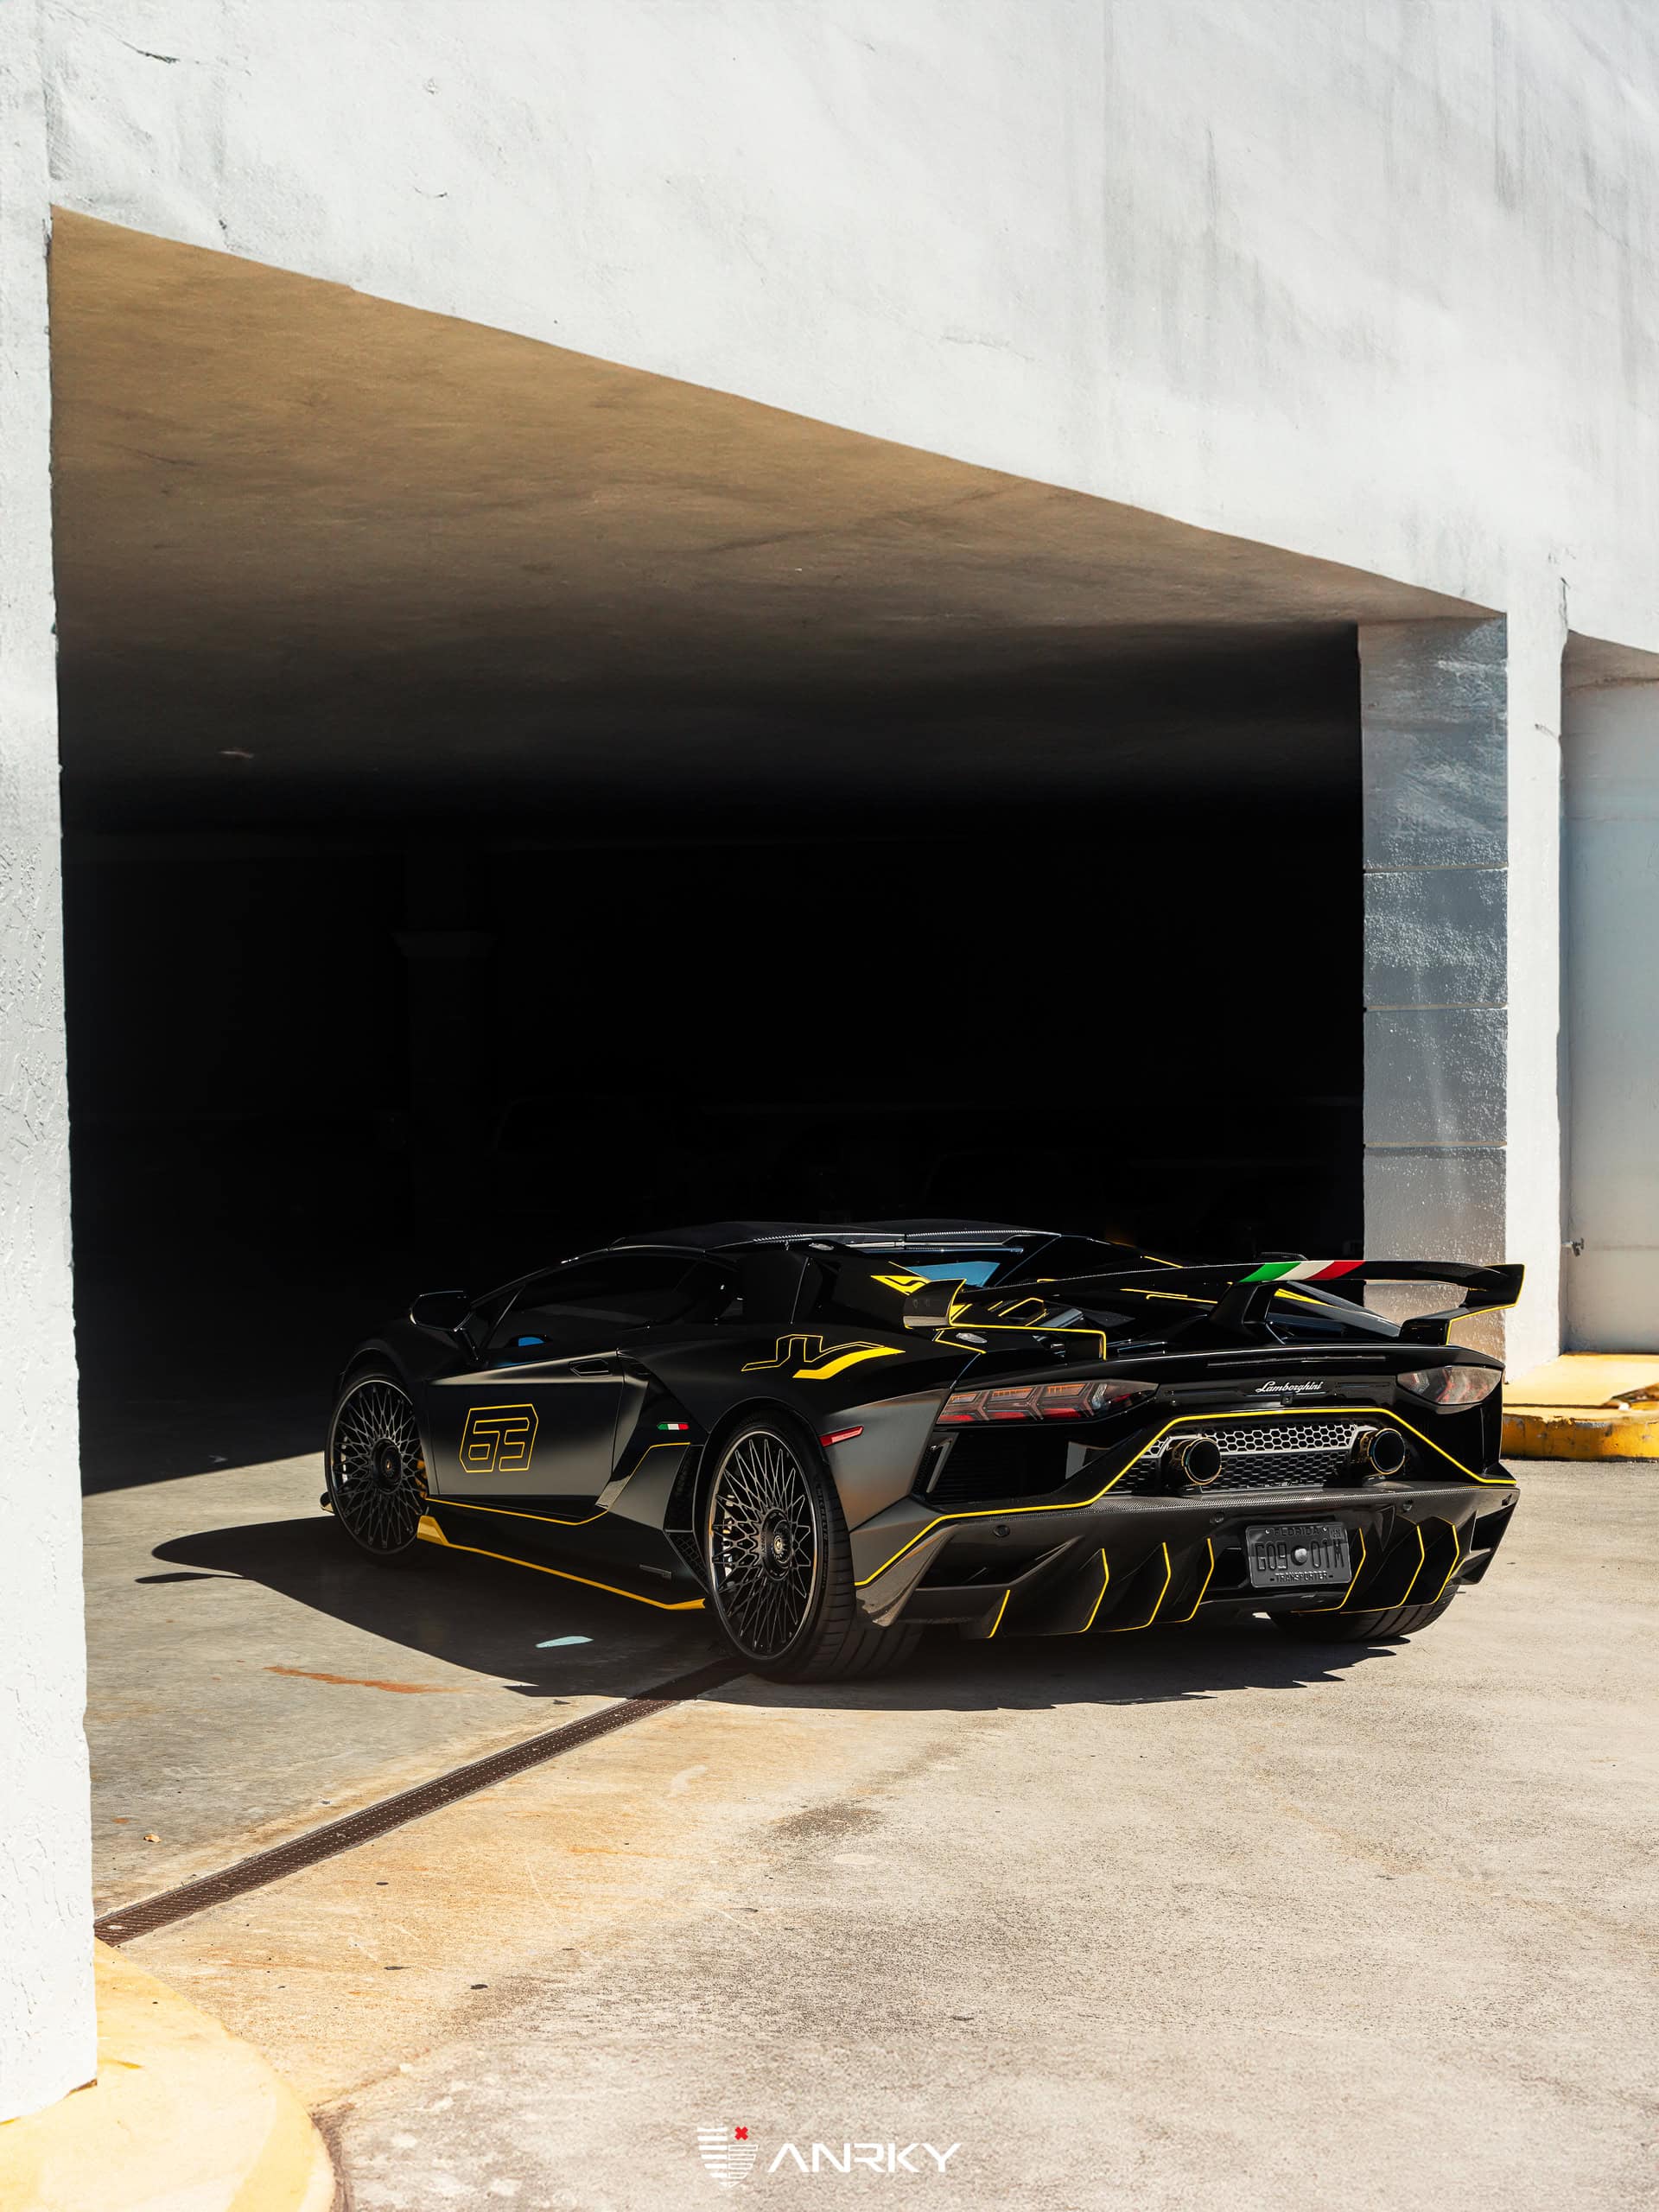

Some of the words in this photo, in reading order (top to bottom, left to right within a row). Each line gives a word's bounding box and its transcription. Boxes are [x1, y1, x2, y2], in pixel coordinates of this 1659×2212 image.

[1255, 1381, 1324, 1393] Lamborghini
[459, 1403, 539, 1473] 63
[1274, 1527, 1320, 1536] FLORIDA
[1274, 1570, 1328, 1583] TRANSPORTER
